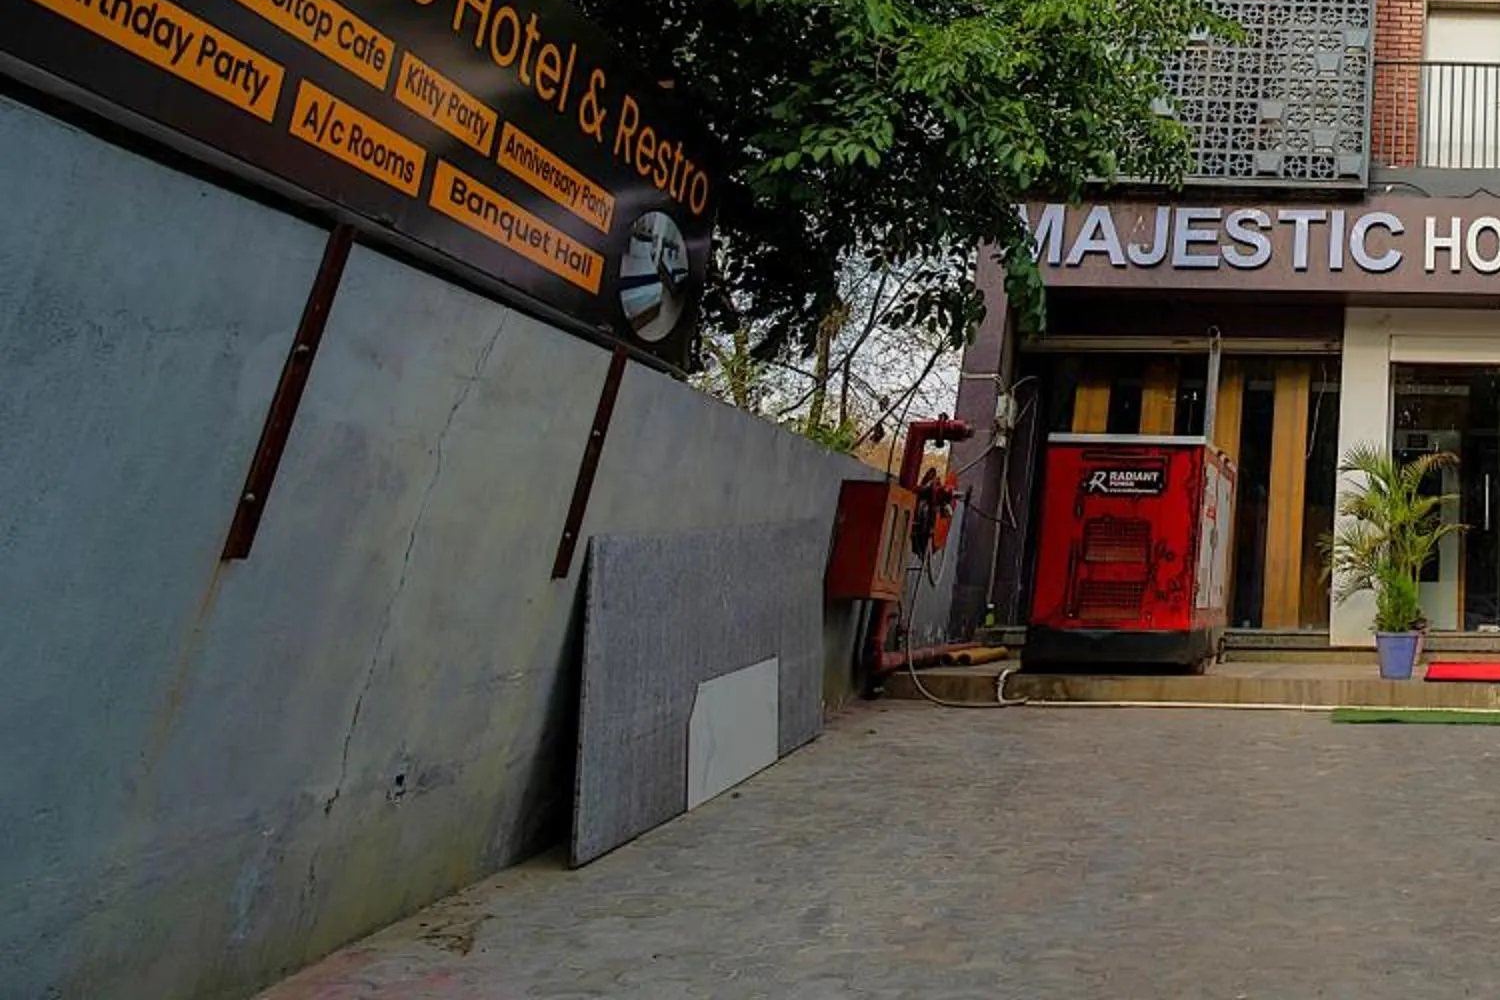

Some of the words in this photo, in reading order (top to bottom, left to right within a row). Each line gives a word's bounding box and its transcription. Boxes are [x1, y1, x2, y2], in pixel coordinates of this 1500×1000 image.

[196, 35, 270, 106] Party
[337, 21, 386, 71] Cafe
[302, 100, 345, 145] A/c
[347, 124, 416, 184] Rooms
[405, 63, 447, 116] Kitty
[448, 96, 490, 145] Party
[579, 68, 607, 143] &
[614, 94, 708, 214] Restro
[505, 134, 582, 198] Anniversary
[583, 185, 611, 222] Party
[450, 177, 551, 245] Banquet
[555, 238, 594, 278] Hall
[1010, 203, 1404, 272] MAJESTIC
[1110, 471, 1160, 482] RADIANT
